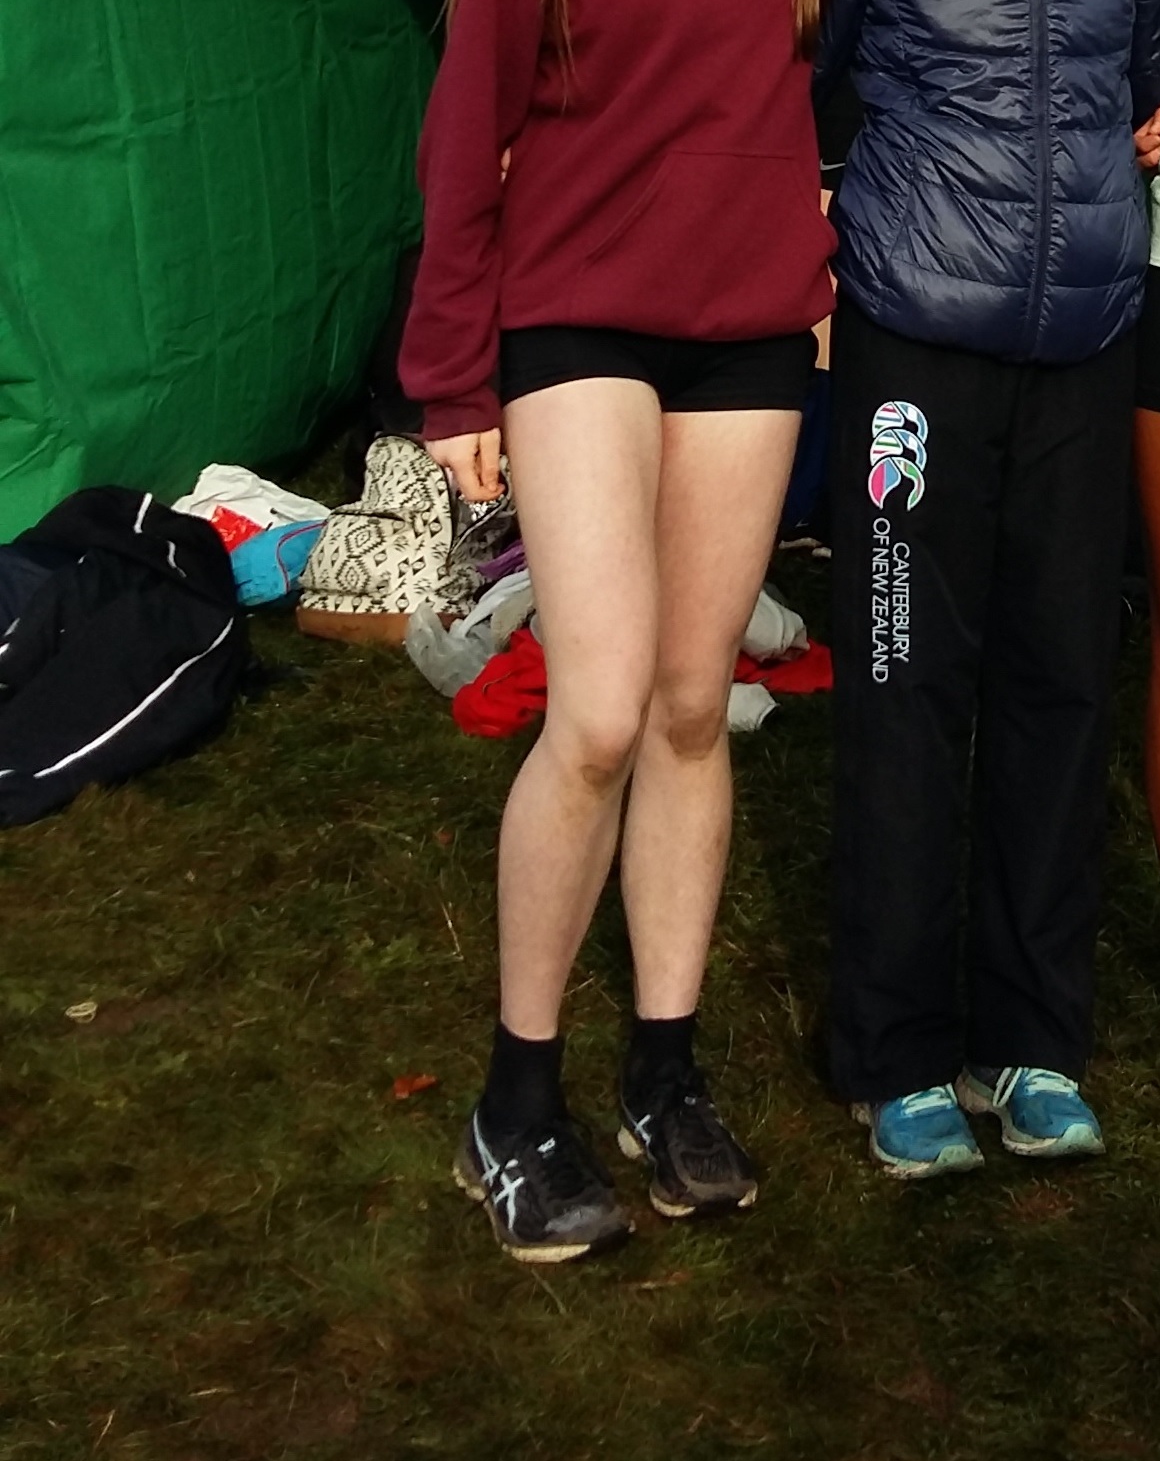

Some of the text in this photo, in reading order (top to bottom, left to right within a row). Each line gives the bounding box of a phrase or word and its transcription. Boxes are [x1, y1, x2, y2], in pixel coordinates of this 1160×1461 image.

[872, 517, 891, 683] OF NEW ZEALAND
[892, 542, 910, 663] CANTERBURY
